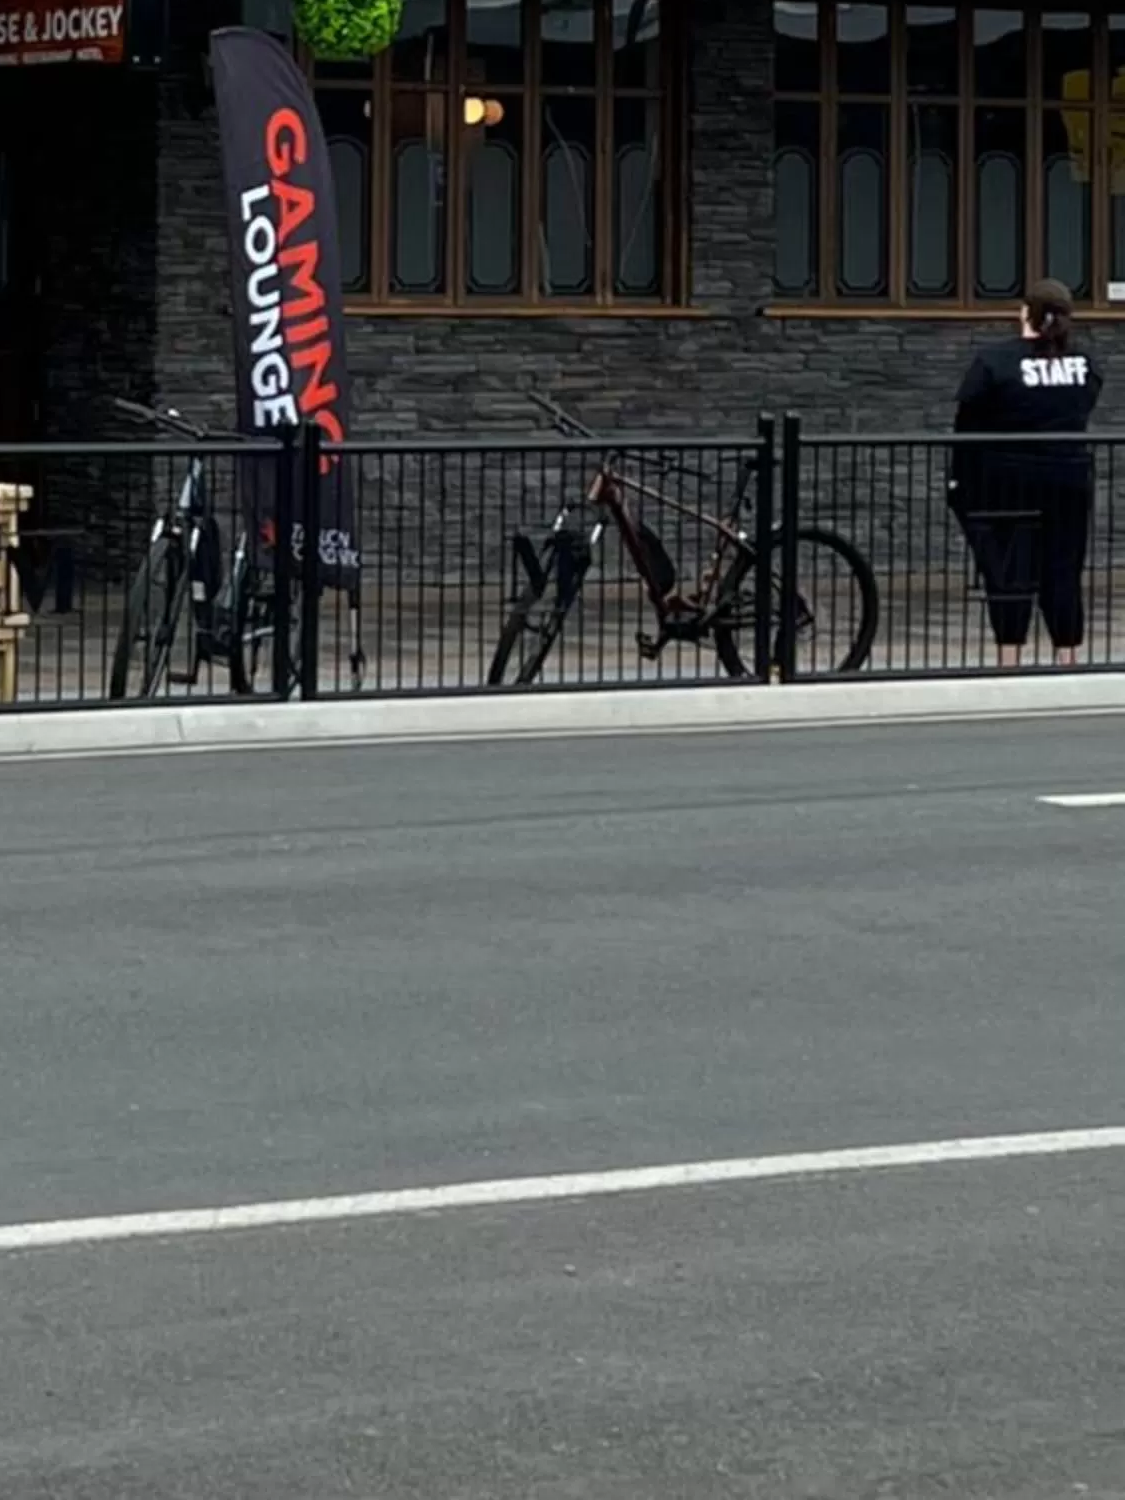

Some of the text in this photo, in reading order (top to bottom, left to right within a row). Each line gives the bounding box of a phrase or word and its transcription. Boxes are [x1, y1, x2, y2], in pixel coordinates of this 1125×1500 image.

[24, 11, 38, 42] &
[41, 4, 124, 41] JOCKEY
[240, 184, 299, 428] LOUNGE
[1019, 355, 1088, 387] STAFF
